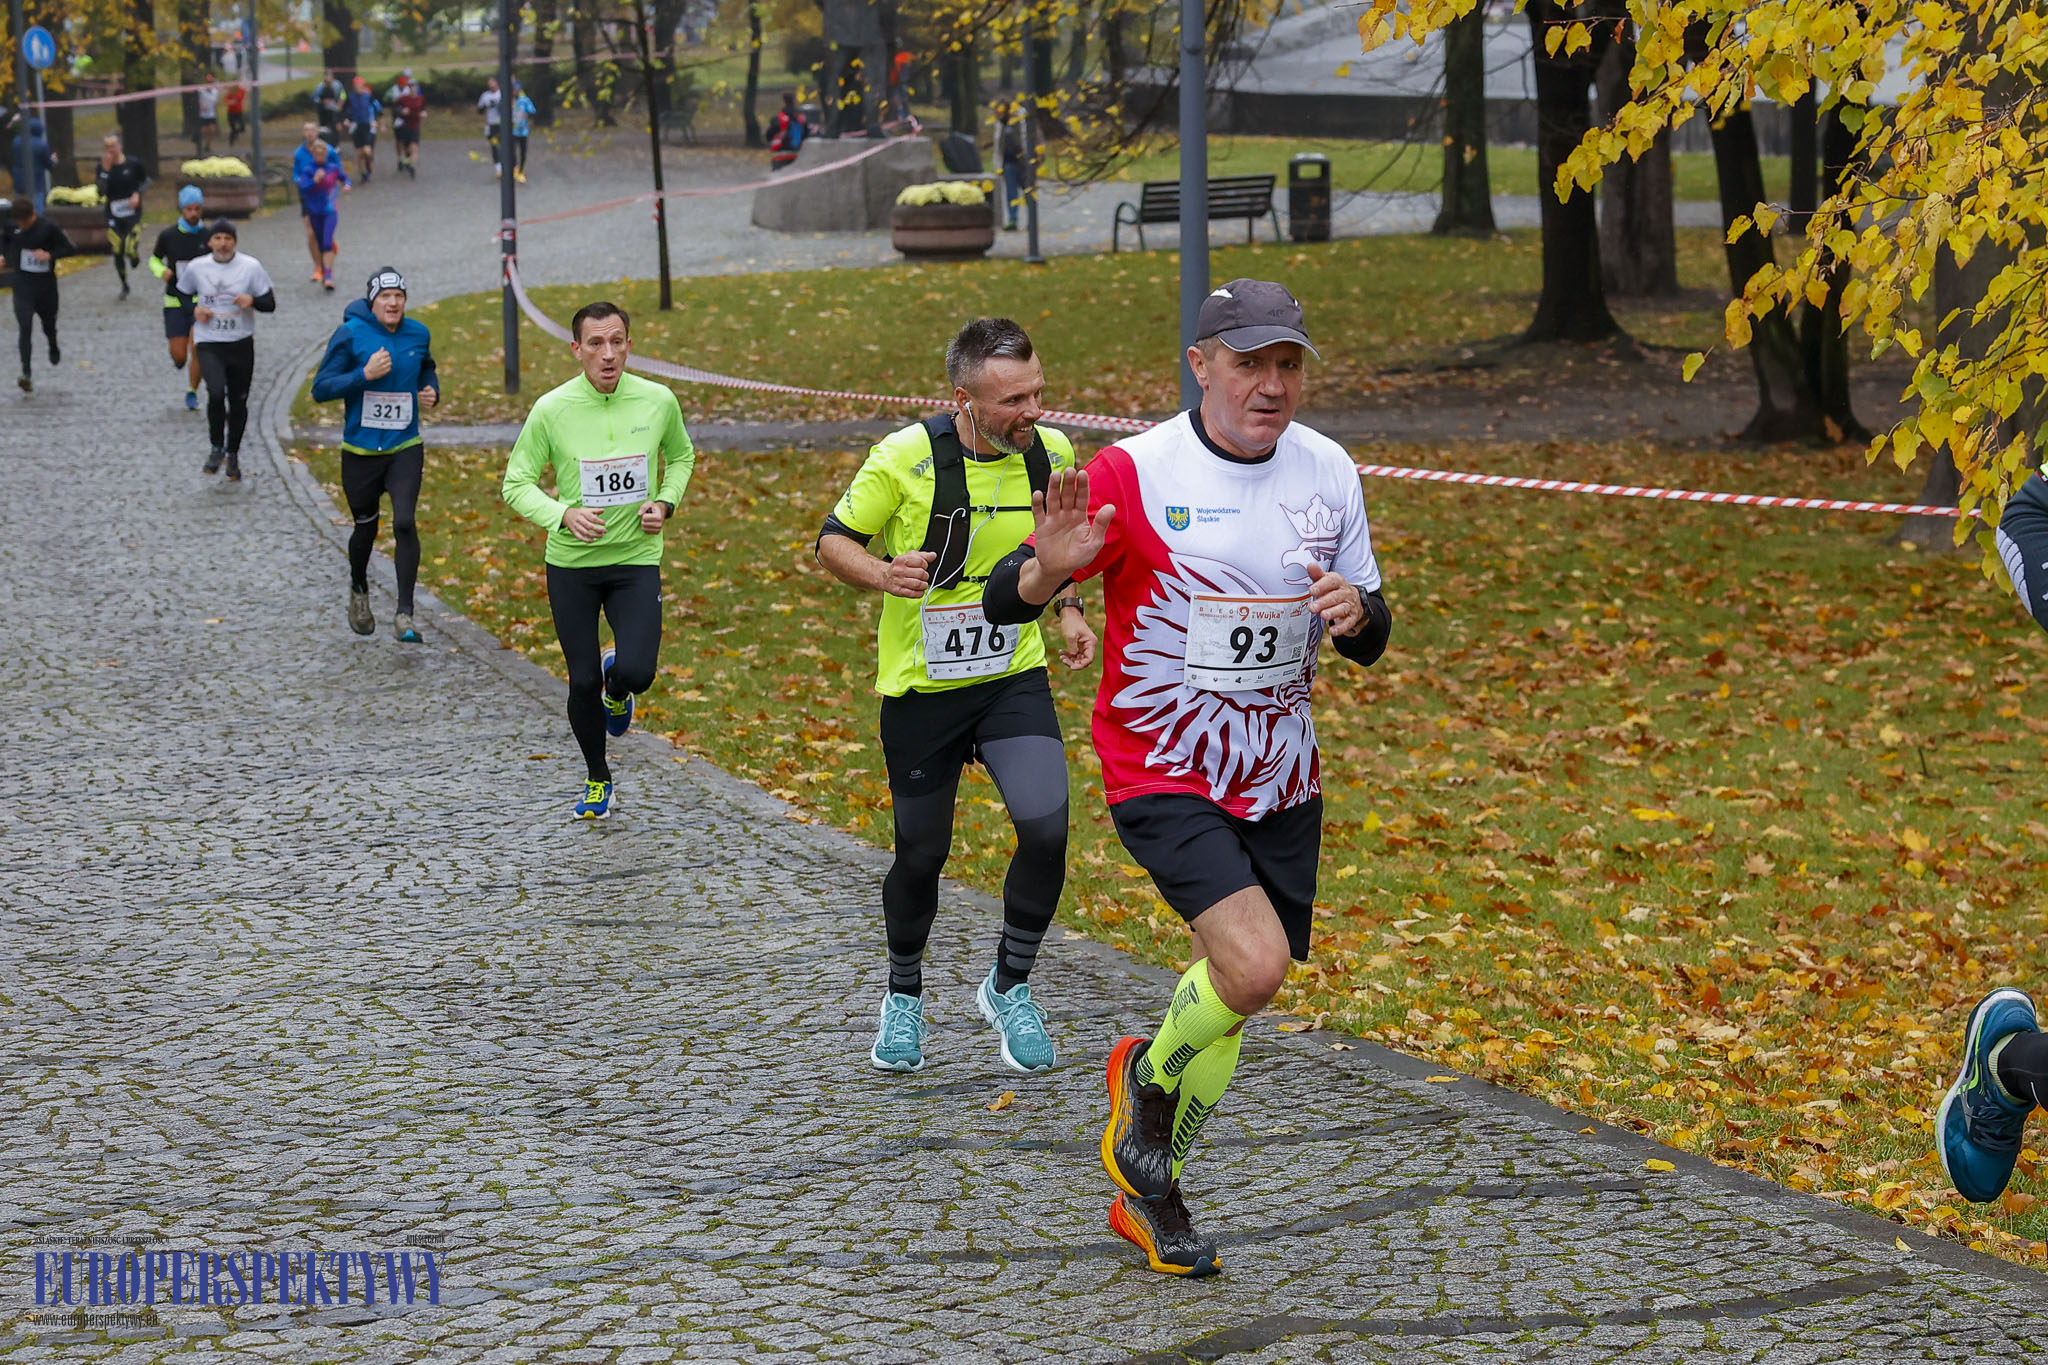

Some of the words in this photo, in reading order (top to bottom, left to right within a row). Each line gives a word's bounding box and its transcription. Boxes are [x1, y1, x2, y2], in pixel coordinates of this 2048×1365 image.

[373, 403, 401, 419] 321
[595, 471, 635, 493] 186
[1196, 507, 1241, 516] Województwo
[1196, 515, 1220, 523] Śląskie
[945, 625, 1005, 657] 476
[1230, 625, 1279, 664] 93
